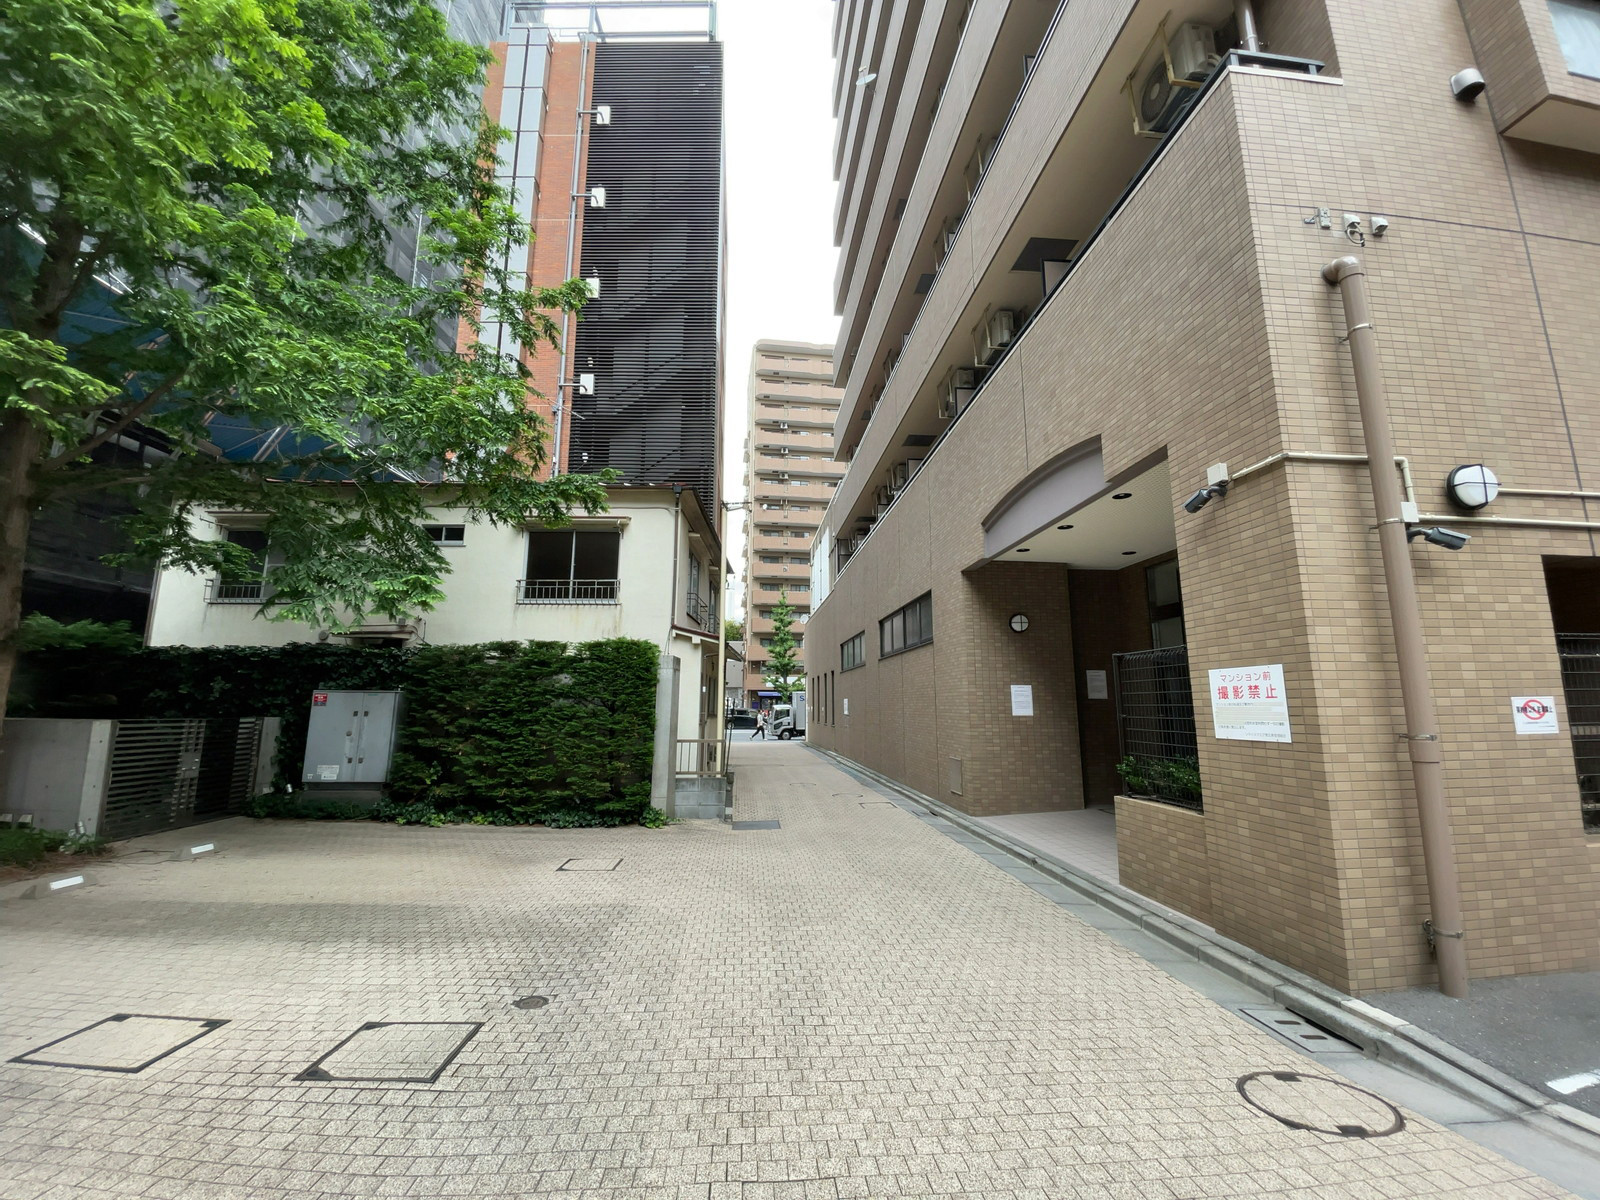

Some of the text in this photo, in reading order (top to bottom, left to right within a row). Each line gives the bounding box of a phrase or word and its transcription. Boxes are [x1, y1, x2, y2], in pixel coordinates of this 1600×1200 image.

[1220, 671, 1271, 682] マンション前
[1217, 684, 1278, 700] 撮影禁止
